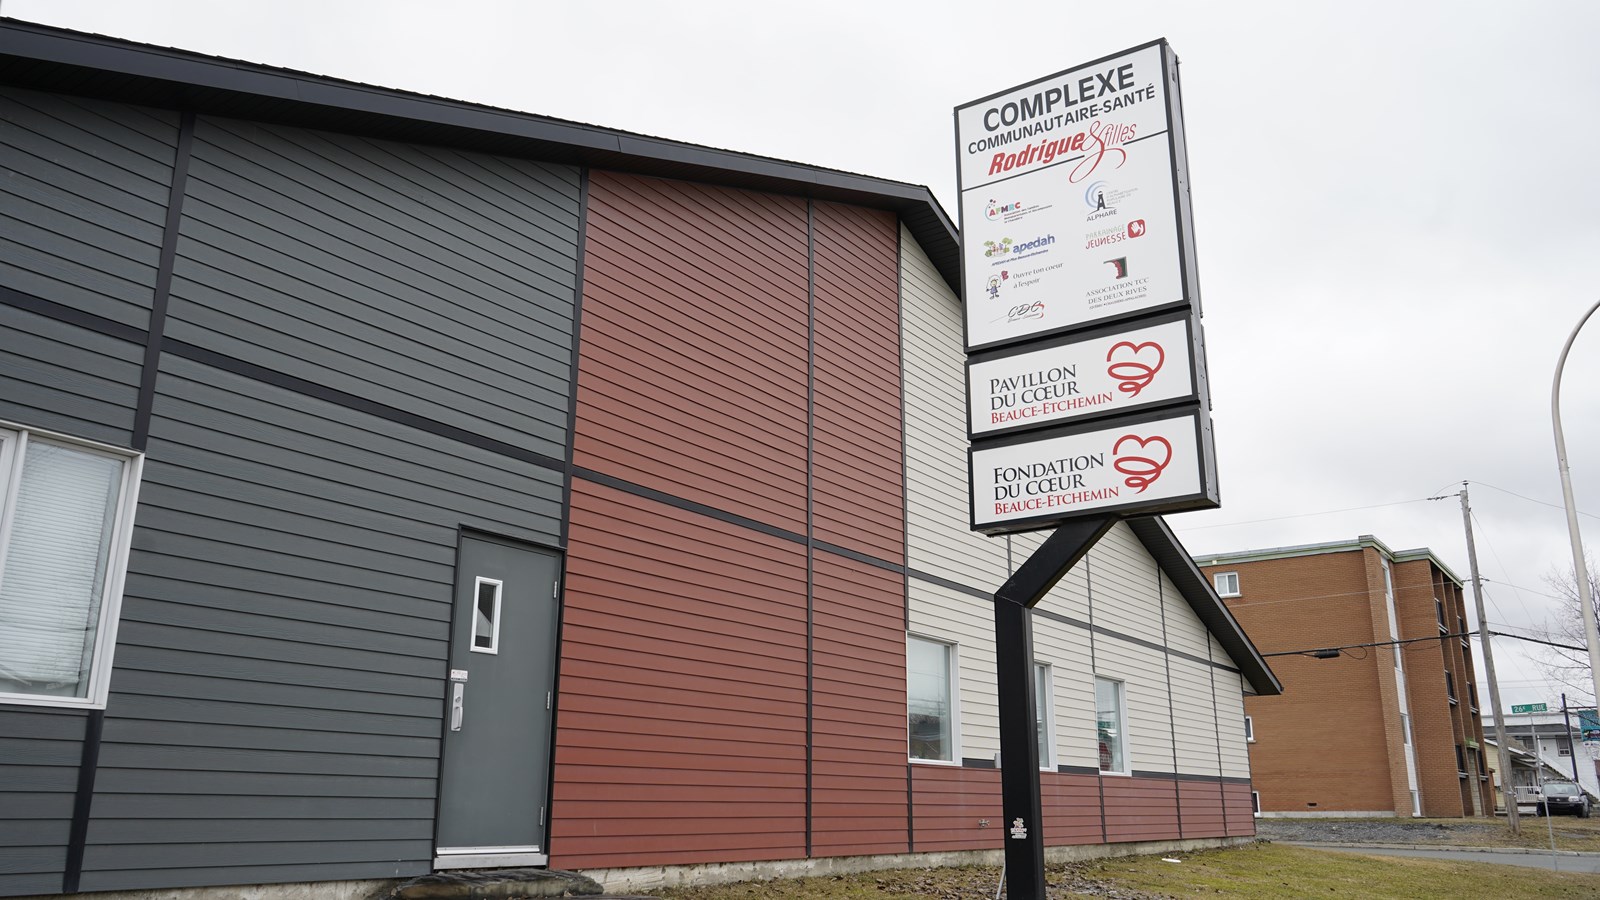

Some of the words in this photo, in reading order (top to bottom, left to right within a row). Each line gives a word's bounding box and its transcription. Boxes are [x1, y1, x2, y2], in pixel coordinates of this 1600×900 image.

[983, 63, 1135, 132] COMPLEXE
[968, 83, 1155, 155] COMMUNAUTAIRE-SANTÉ
[988, 131, 1085, 176] Rodrigue
[1103, 123, 1137, 147] filles
[989, 201, 1021, 217] APMRC
[1086, 208, 1118, 222] ALPHARE
[1012, 233, 1056, 255] apedah
[1085, 231, 1127, 250] JEUNESSE
[1012, 270, 1033, 280] Ouvre
[1033, 266, 1045, 275] ton
[1086, 280, 1134, 297] ASSOCIATION
[1134, 276, 1150, 286] TCC
[1088, 297, 1103, 305] DES
[1103, 291, 1124, 301] DEUX
[1125, 285, 1148, 296] RIVES
[990, 364, 1077, 395] PAVILLON
[991, 393, 1017, 411] DU
[1021, 381, 1080, 405] CŒUR
[993, 453, 1104, 484] FONDATION
[994, 484, 1020, 500] DU
[1026, 473, 1086, 496] CŒUR
[1532, 703, 1545, 711] RUE
